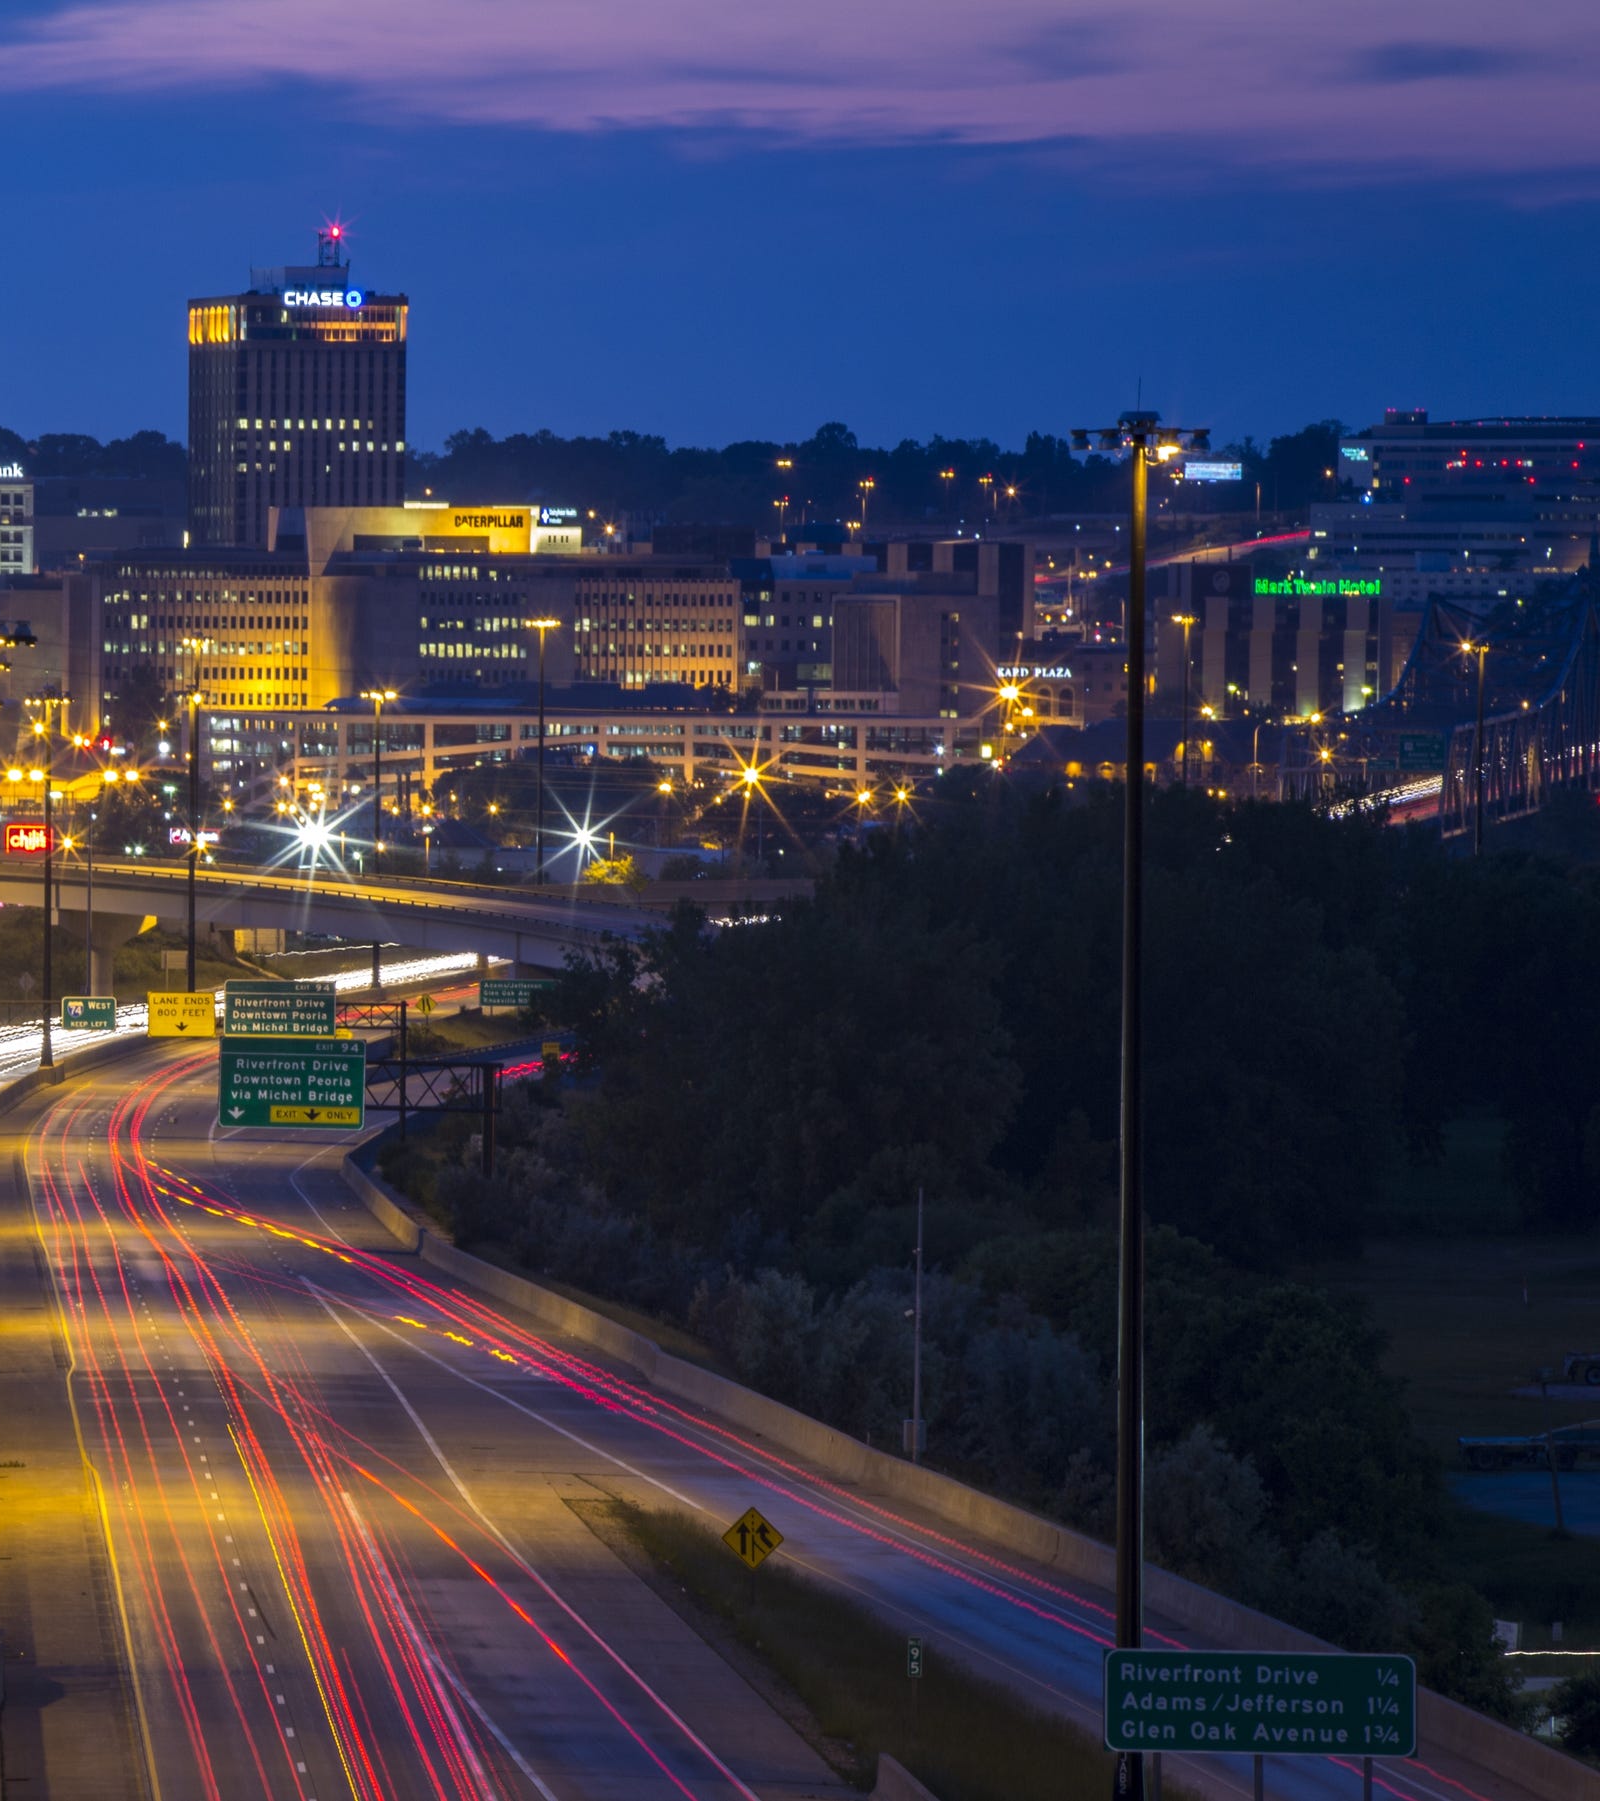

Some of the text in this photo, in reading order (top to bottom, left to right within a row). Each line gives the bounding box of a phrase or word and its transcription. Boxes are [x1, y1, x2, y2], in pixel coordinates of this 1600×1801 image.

[284, 292, 344, 306] CHASE
[454, 515, 524, 528] CATERPILLAR
[1255, 578, 1381, 595] Mark Twain Hotel
[1034, 667, 1072, 678] PLAZA
[153, 997, 210, 1005] LANE ENDS
[234, 998, 326, 1007] Riverfront Drive
[70, 1007, 82, 1015] 74
[157, 1009, 206, 1017] 800 FEET
[232, 1010, 328, 1020] Downtown Peoria
[231, 1023, 247, 1031] via
[252, 1023, 288, 1031] Michel
[293, 1023, 329, 1034] Bridge
[315, 1043, 359, 1053] EXIT 94
[236, 1058, 349, 1072] Riverfront Drive
[233, 1074, 352, 1087] Downtown Peoria
[231, 1090, 353, 1104] via Michel Bridge
[276, 1110, 353, 1119] EXIT ONLY
[1120, 1663, 1242, 1684] Riverfront
[1256, 1665, 1320, 1686] Drive
[1121, 1720, 1176, 1740] Glen
[1190, 1721, 1237, 1741] Oak
[1252, 1722, 1349, 1743] Avenue
